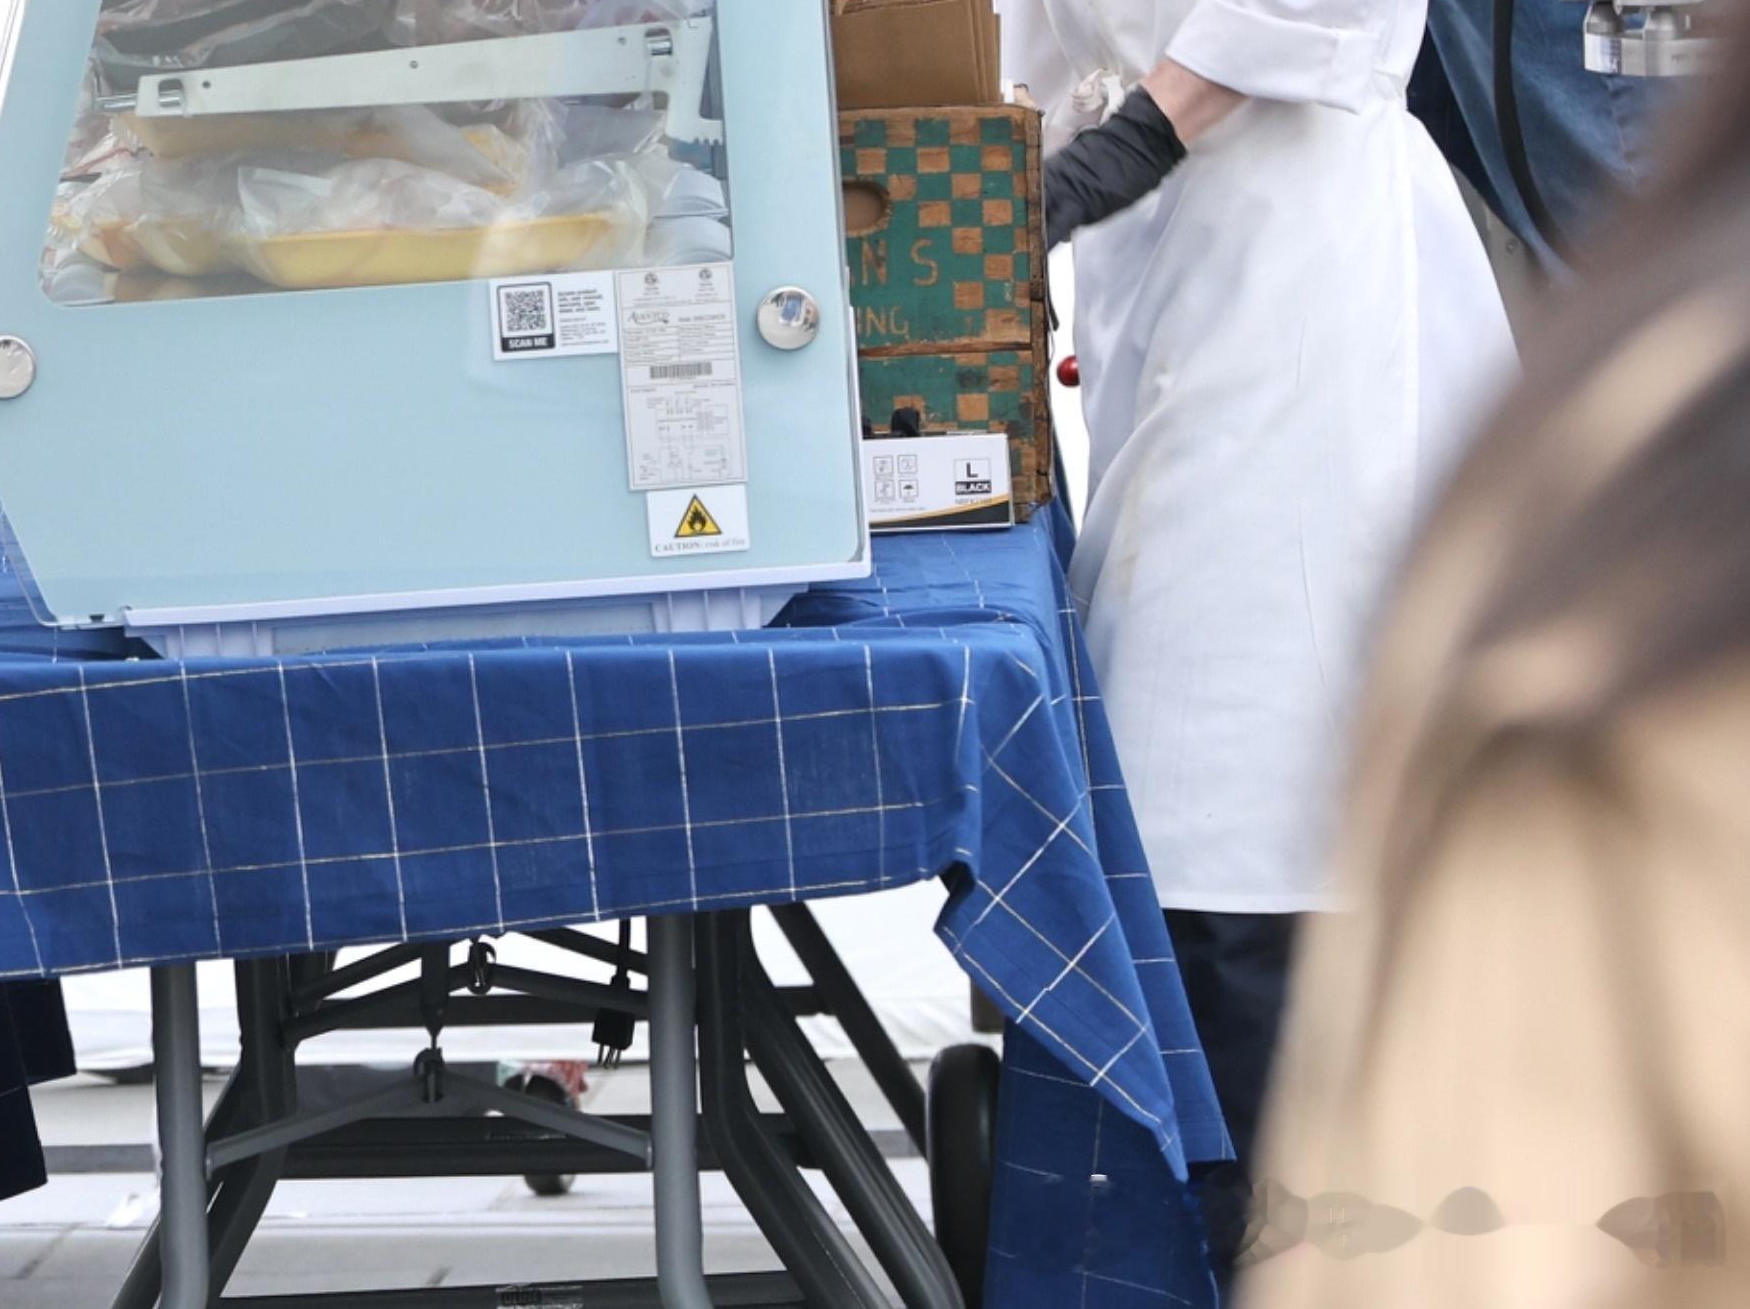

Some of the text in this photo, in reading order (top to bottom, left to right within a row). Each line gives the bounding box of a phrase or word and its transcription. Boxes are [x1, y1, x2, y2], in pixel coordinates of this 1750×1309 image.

[509, 338, 533, 349] SCAN
[534, 336, 548, 347] ME
[966, 462, 979, 478] L
[955, 482, 991, 494] BLACK
